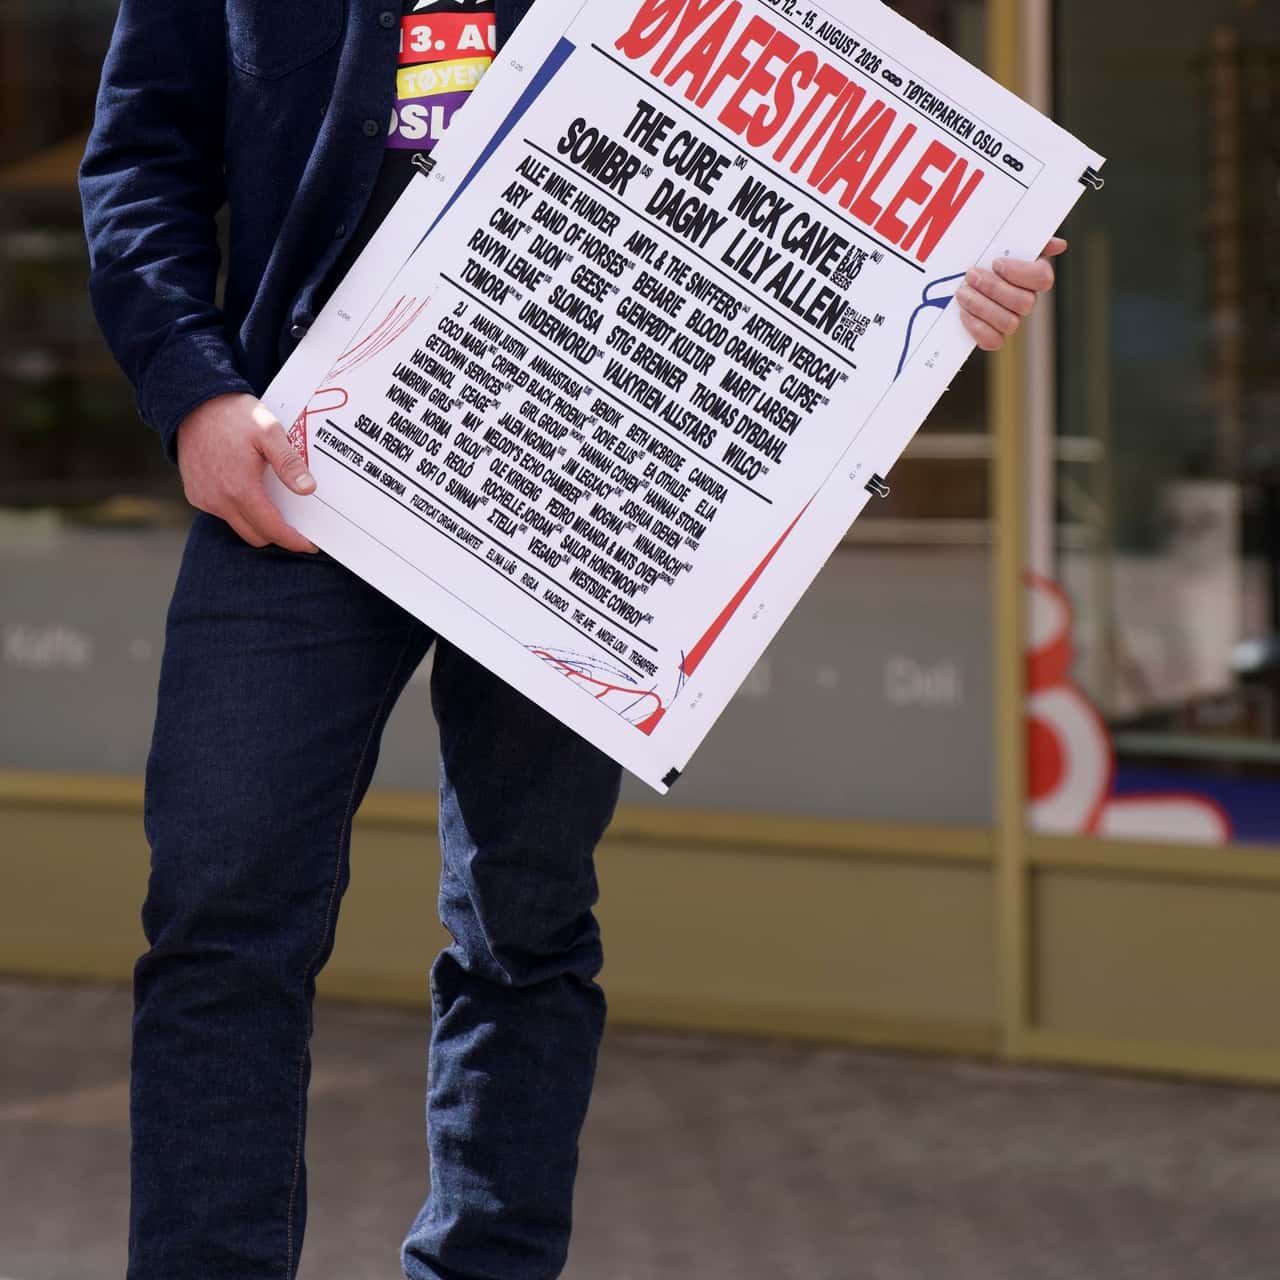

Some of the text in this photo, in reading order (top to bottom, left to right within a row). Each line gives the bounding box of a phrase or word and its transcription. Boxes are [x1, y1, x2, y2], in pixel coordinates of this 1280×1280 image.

[814, 20, 861, 58] AUGUST
[854, 47, 883, 75] 2026
[902, 79, 977, 140] TØYENPARKEN
[971, 129, 1003, 159] OSLO
[514, 154, 842, 391] ALLE MINE HUNDER AMYL & THE SNIFFERS ARTHUR VEROCAI
[556, 117, 850, 336] SOMBR DAGNY LILY ALLEN
[622, 98, 677, 157] THE
[662, 129, 733, 196] CURE
[727, 175, 795, 240] NICK
[780, 211, 850, 278] CAVE
[828, 269, 853, 292] SEEDS
[835, 254, 862, 281] BAD
[845, 244, 870, 267] & THE
[459, 257, 763, 481] TOMORA UNDERWORLD VALKYRIEN ALLSTARS WILCO
[466, 227, 788, 465] RAVYN LENAE SLOMOSA STIG BRENNER THOMAS DYBDAHL
[488, 207, 803, 437] CMAT DIJON GEESE GJENFØDT KULTUR MARIT LARSEN
[500, 180, 824, 415] ARY BAND OF HORSES BEHARIE BLOOD ORANGE CLIPSE
[831, 323, 859, 353] GIRL
[839, 315, 866, 337] WEST END
[843, 306, 871, 330] SPILLER
[385, 383, 662, 587] NONNE NORMA OKLOU OLE KIRKENG PEDRO MIRANDA & MATS OVEN
[391, 361, 433, 398] LAMBRINI
[428, 387, 456, 414] GIRLS
[460, 410, 485, 433] MAY
[518, 452, 546, 478] ECHO
[541, 468, 583, 506] CHAMBER
[588, 502, 628, 537] MOGWAI
[424, 333, 707, 541] GETDOWN SERVICES GIRL GROUP HANNAH COHEN HANNAH STORM
[437, 315, 465, 342] COCO
[490, 354, 531, 389] CRIPPLED
[525, 378, 557, 408] BLACK
[550, 396, 590, 431] PHOENIX
[591, 424, 619, 452] DOVE
[642, 461, 659, 481] EA
[654, 470, 692, 503] OTHILDE
[694, 498, 718, 523] ELIA
[452, 300, 729, 504] 2J ANAKIN JUSTIN ANNAHSTASIA BENDIK BETH MCBRIDE CANDURA
[458, 383, 493, 414] ICEAGE
[497, 411, 527, 438] JALEN
[520, 427, 558, 462] NGONDA
[560, 456, 581, 477] JIM
[574, 465, 616, 501] LEGXACY
[618, 498, 655, 531] JOSHUA
[649, 519, 684, 551] IDEHEN
[353, 413, 384, 443] SELMA
[378, 431, 415, 463] FRENCH
[444, 477, 482, 511] SUNNAN
[527, 535, 564, 569] VEGARD
[568, 565, 612, 605] WESTSIDE
[606, 593, 647, 628] COWBOY
[386, 410, 430, 448] RAGNHILD
[425, 438, 443, 457] OG
[480, 477, 527, 517] ROCHELLE
[519, 506, 558, 539] JORDAN
[559, 533, 592, 565] SAILOR
[586, 553, 642, 599] HONEYMOON
